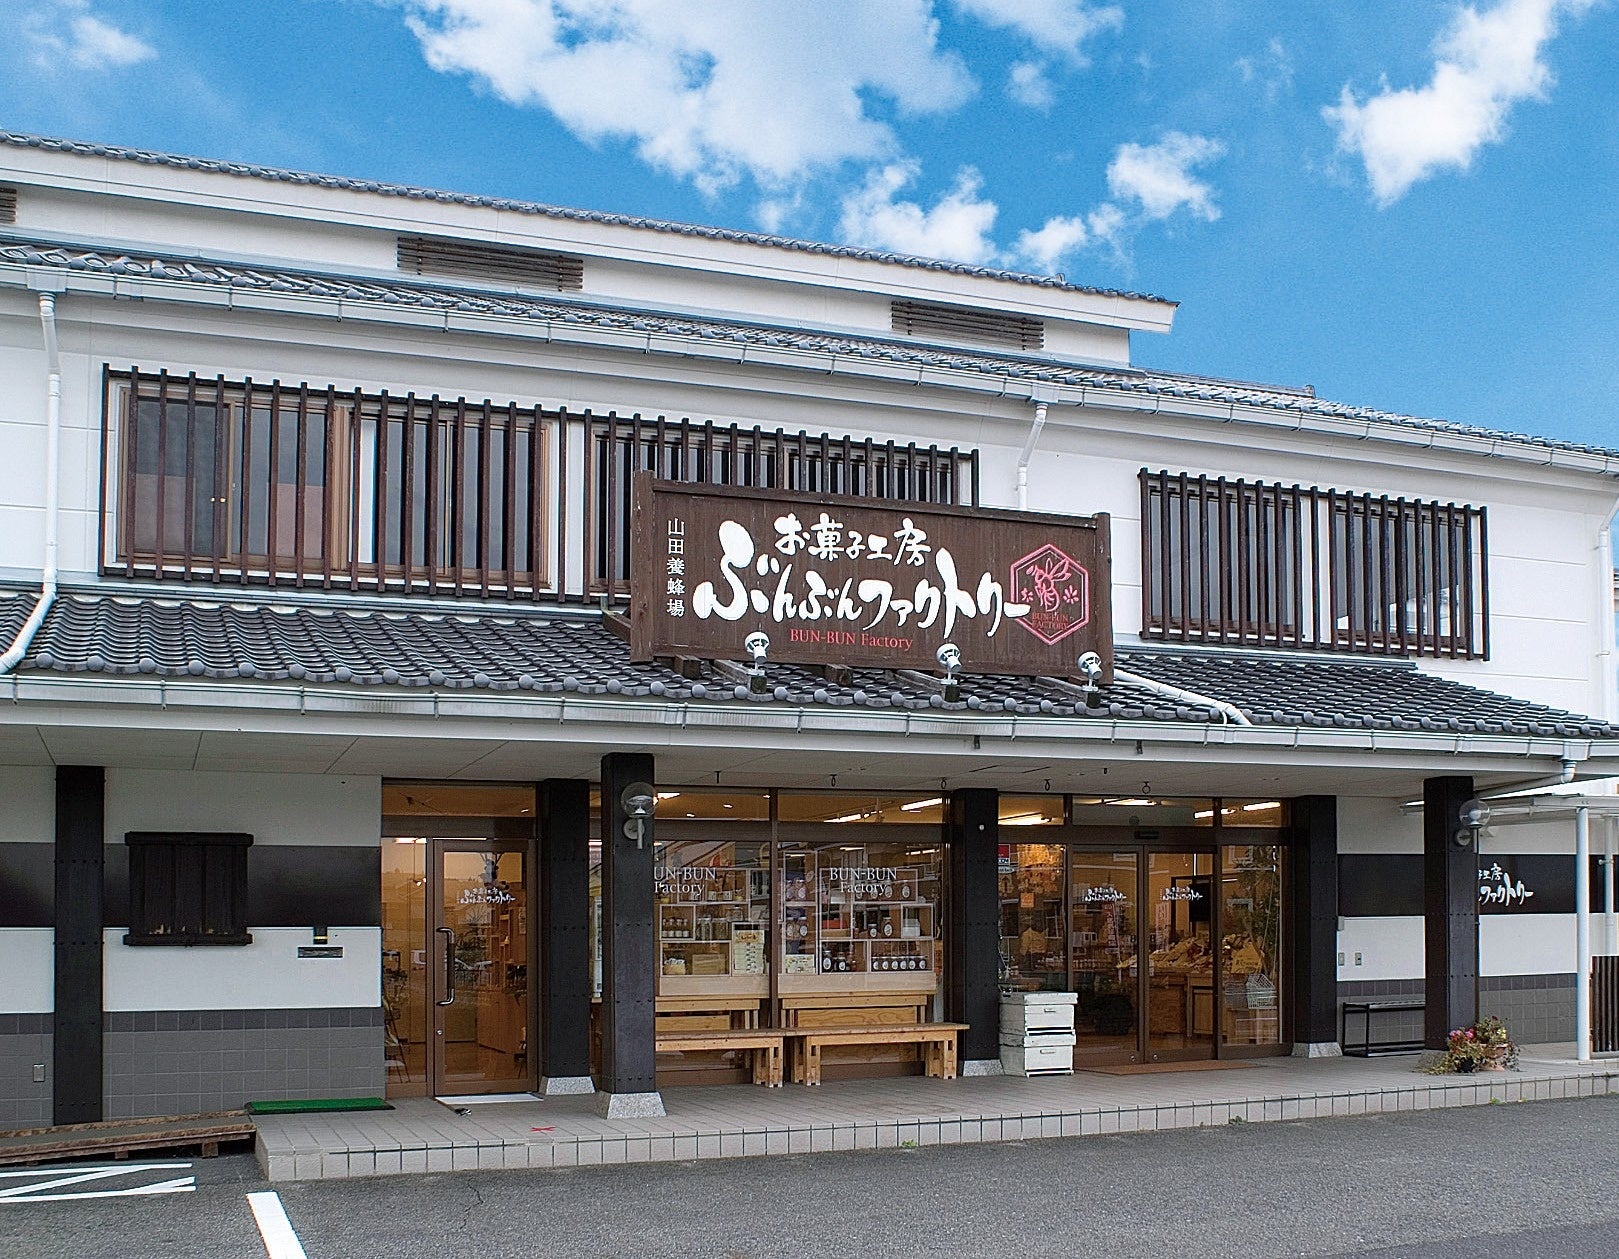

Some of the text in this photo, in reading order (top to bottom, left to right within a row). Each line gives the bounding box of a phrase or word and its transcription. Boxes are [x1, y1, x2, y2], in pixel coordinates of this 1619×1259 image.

[774, 513, 931, 566] お菓子工房
[667, 518, 685, 617] 山田養蜂場
[692, 520, 1031, 639] ぶんぶんファクトリー
[790, 629, 913, 651] BUN-BUN Factory
[653, 867, 716, 880] UN-BUN
[830, 867, 897, 880] BUN-BUN
[654, 881, 704, 896] Factory
[840, 882, 887, 896] Factory
[1479, 872, 1534, 906] ファクトリー
